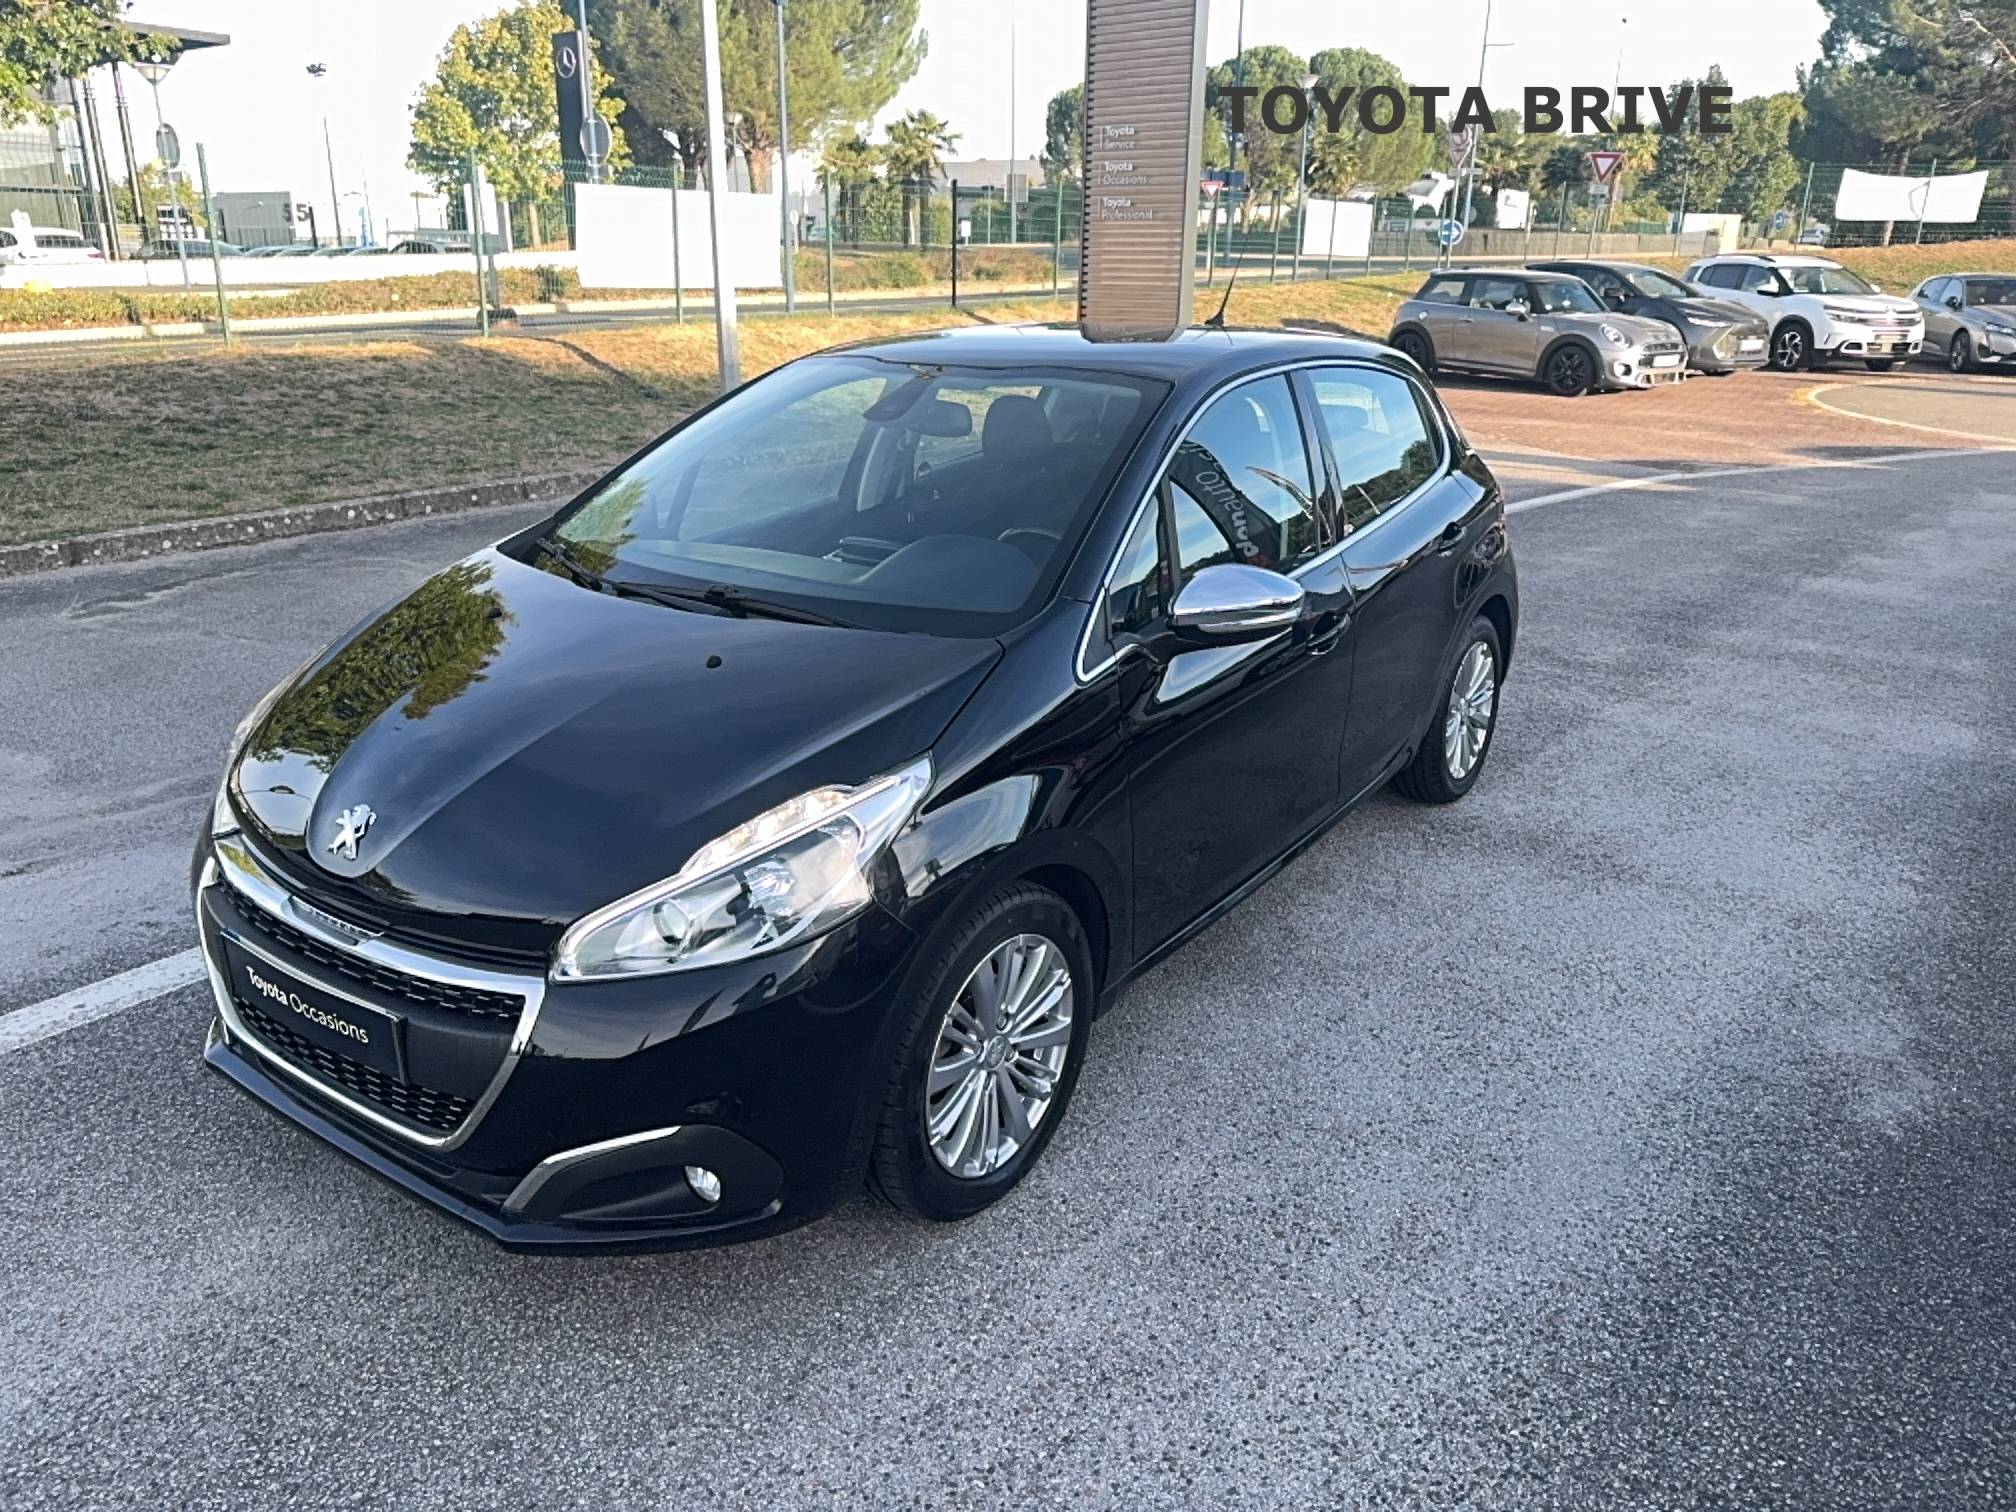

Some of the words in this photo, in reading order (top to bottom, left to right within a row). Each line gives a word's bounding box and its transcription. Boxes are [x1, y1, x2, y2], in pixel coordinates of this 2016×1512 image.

[1104, 126, 1135, 138] Toyota
[1104, 139, 1135, 149] Service
[1104, 161, 1134, 174] Toyota
[1103, 175, 1147, 185] Occasions
[1102, 197, 1132, 209] Toyota
[1101, 209, 1153, 220] Professional
[245, 965, 288, 1006] Toyota
[289, 993, 369, 1043] Occasions
